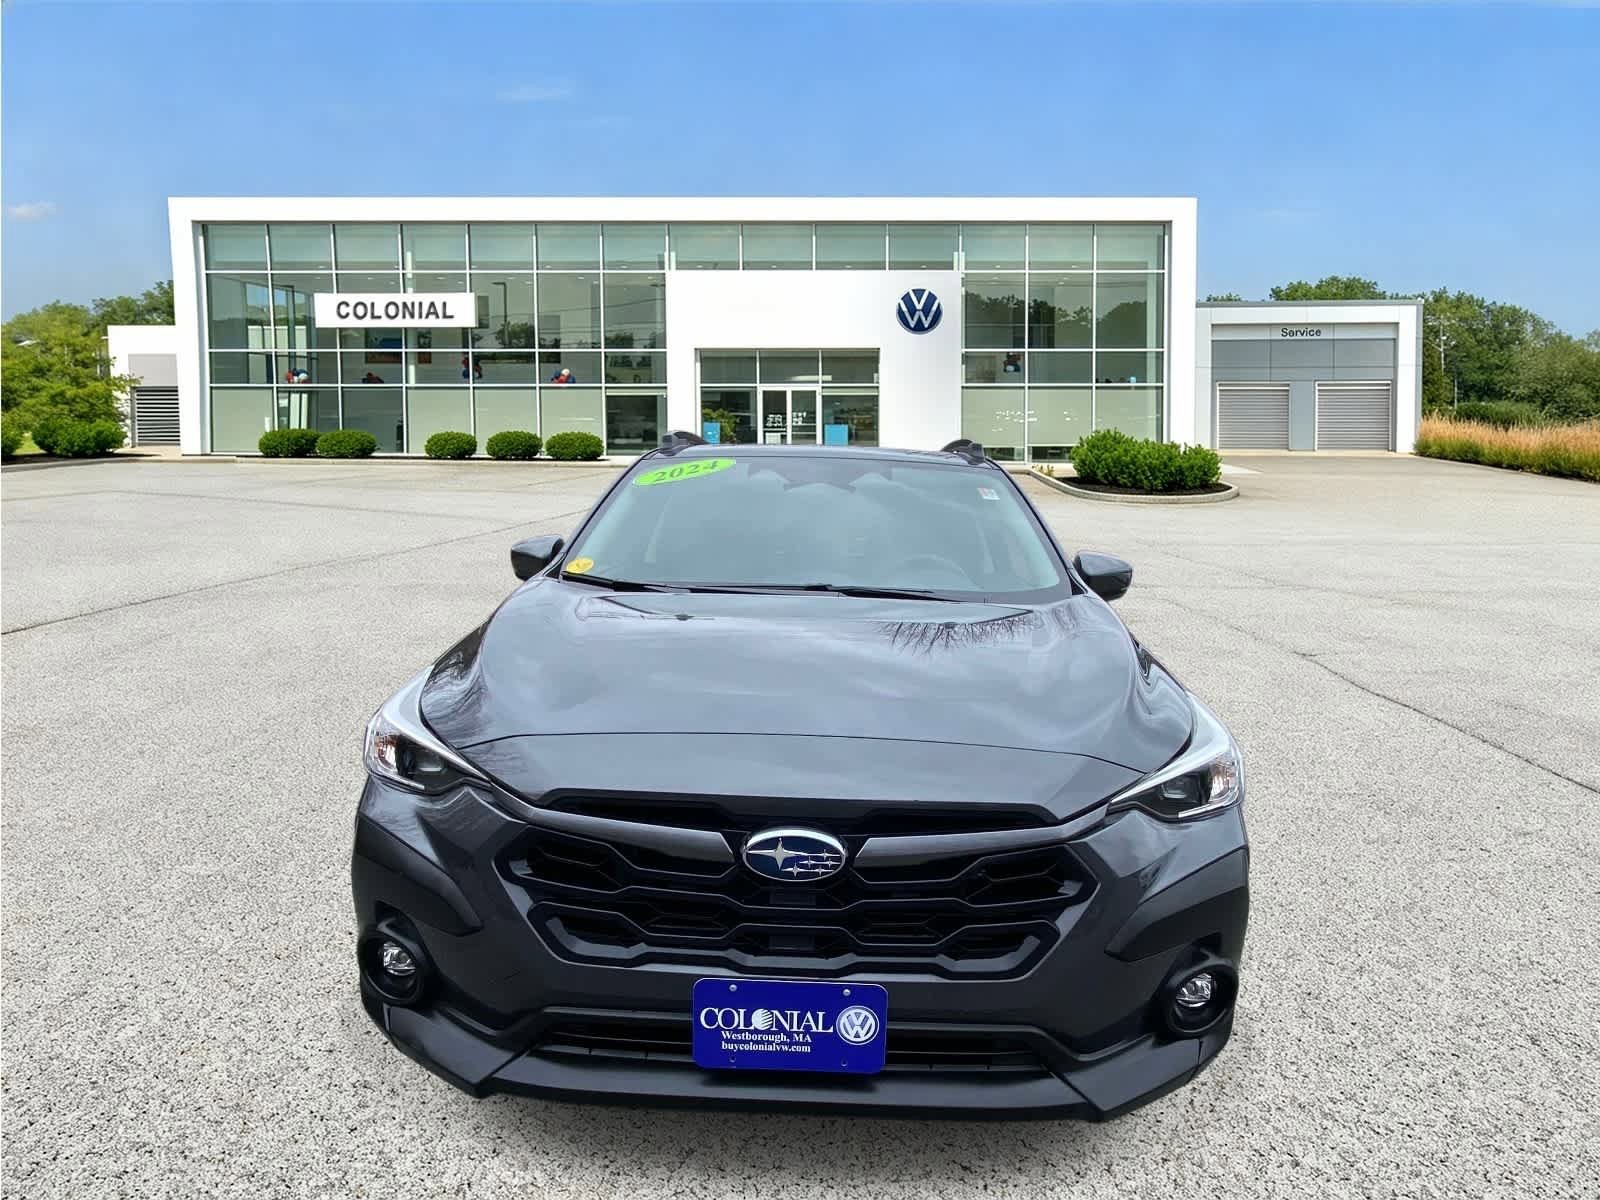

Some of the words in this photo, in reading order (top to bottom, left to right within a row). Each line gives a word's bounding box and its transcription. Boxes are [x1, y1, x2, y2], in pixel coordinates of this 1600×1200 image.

[336, 301, 455, 320] COLONIAL
[898, 288, 941, 331] VW
[1281, 327, 1321, 337] Service
[655, 461, 718, 482] 2024
[700, 1007, 833, 1033] COLONIAL
[721, 1031, 790, 1043] Westborough,
[793, 1033, 812, 1043] MA
[721, 1041, 811, 1053] buycolonialvw.com
